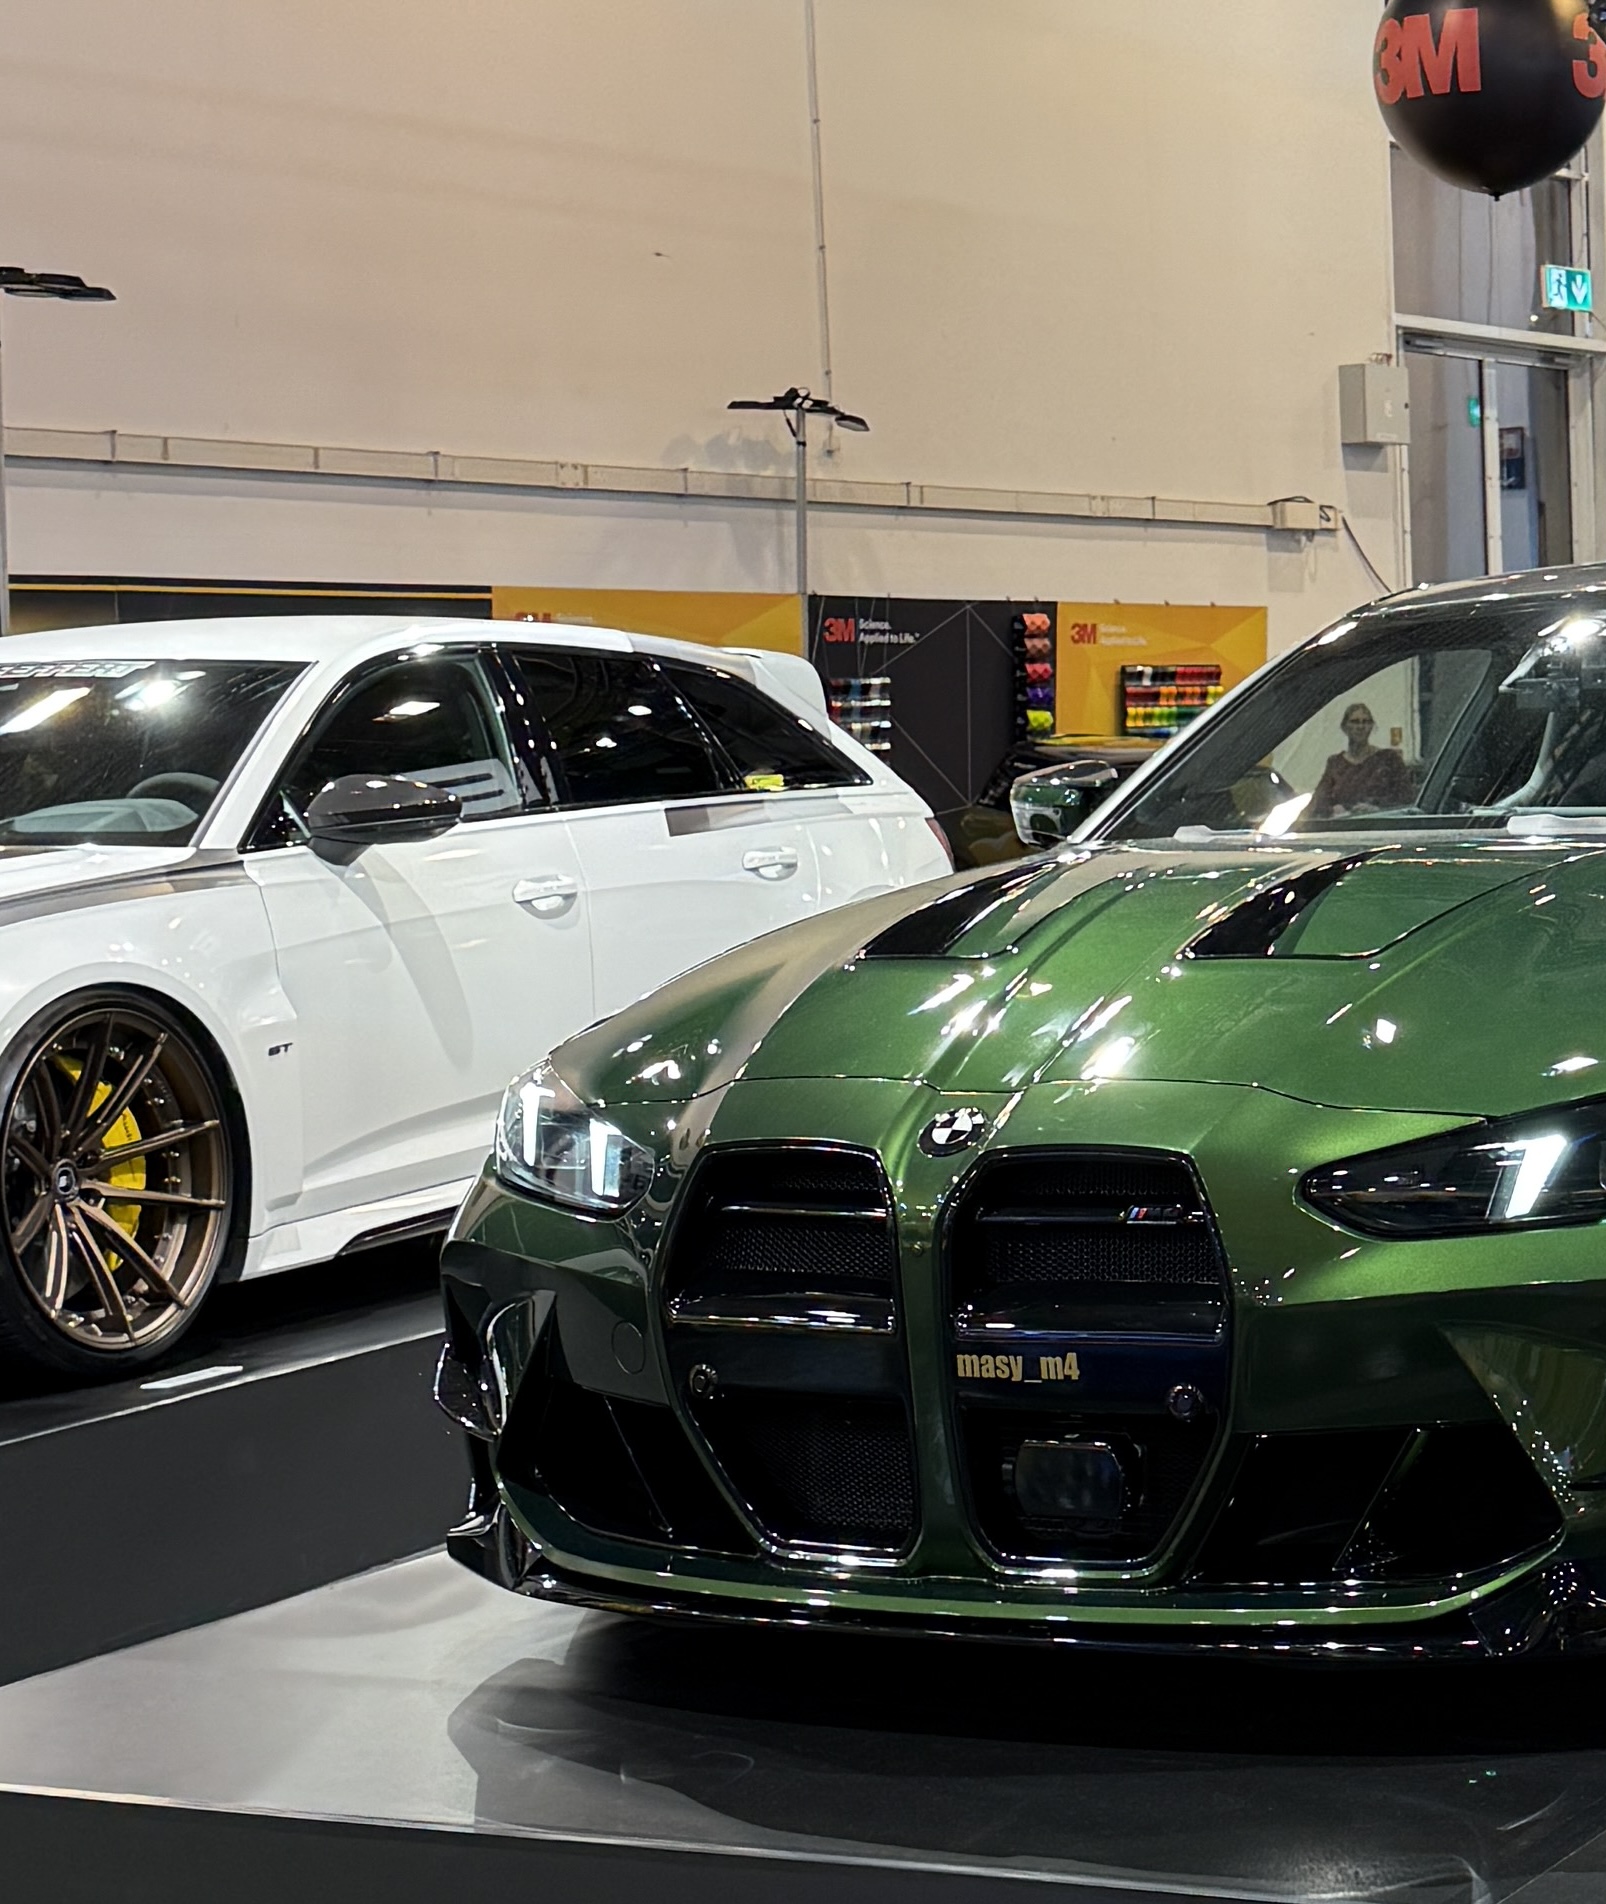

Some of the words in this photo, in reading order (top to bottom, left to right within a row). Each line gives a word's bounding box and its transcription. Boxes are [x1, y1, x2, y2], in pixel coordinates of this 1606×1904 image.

[1374, 8, 1481, 105] 3M
[824, 618, 855, 642] 3M
[1071, 624, 1097, 645] 3M
[956, 1352, 1080, 1383] masy_m4
